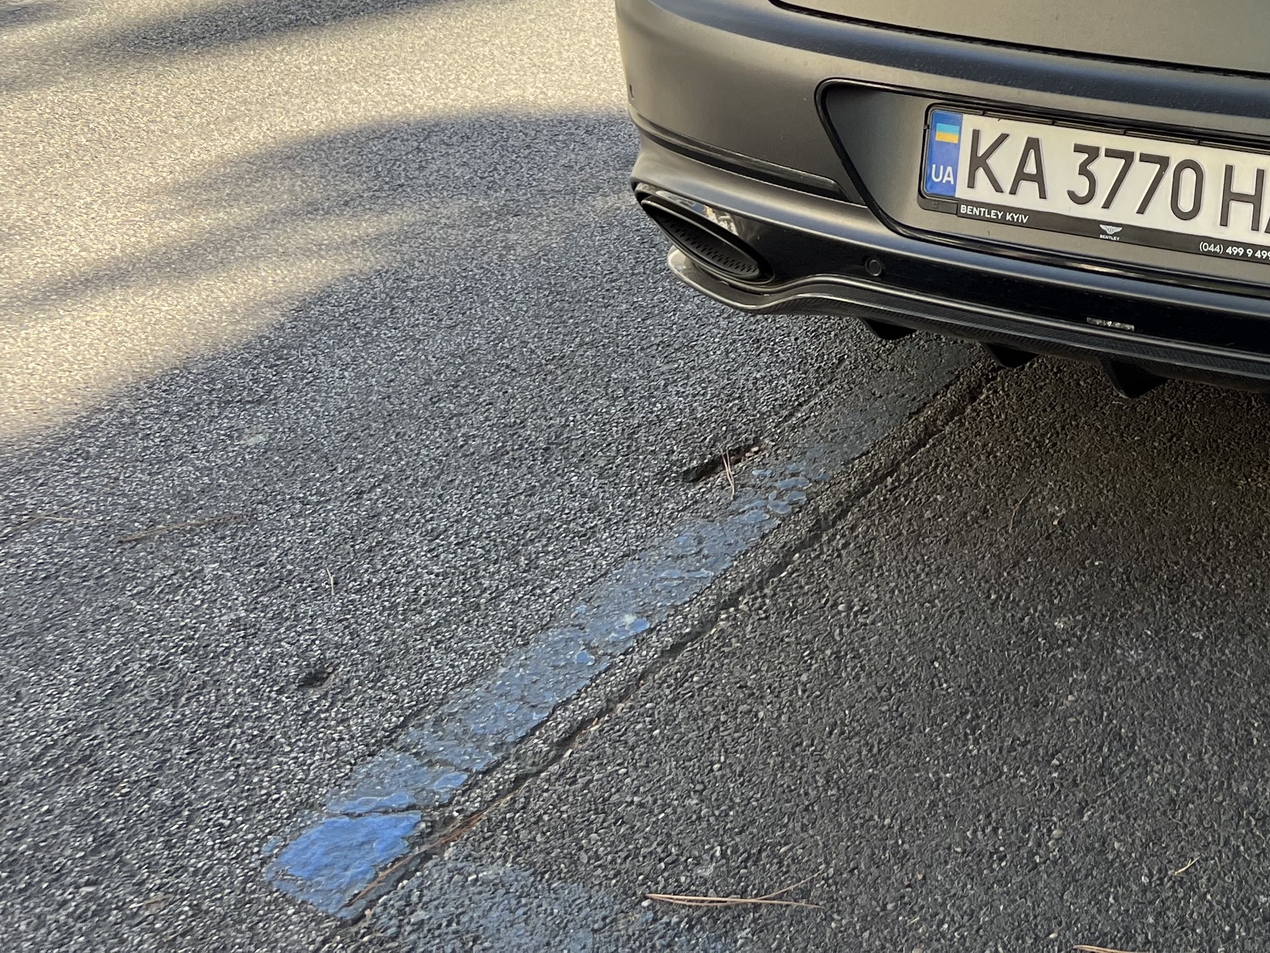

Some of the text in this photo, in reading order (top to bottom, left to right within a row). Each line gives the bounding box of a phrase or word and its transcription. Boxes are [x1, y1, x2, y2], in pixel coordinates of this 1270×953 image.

[931, 163, 954, 185] UA
[967, 129, 1047, 200] KA
[1067, 143, 1204, 221] 3770
[960, 204, 1030, 224] BENTLEY KYIV
[1199, 241, 1224, 254] (044)
[1226, 246, 1244, 256] 499
[1246, 248, 1253, 257] 9
